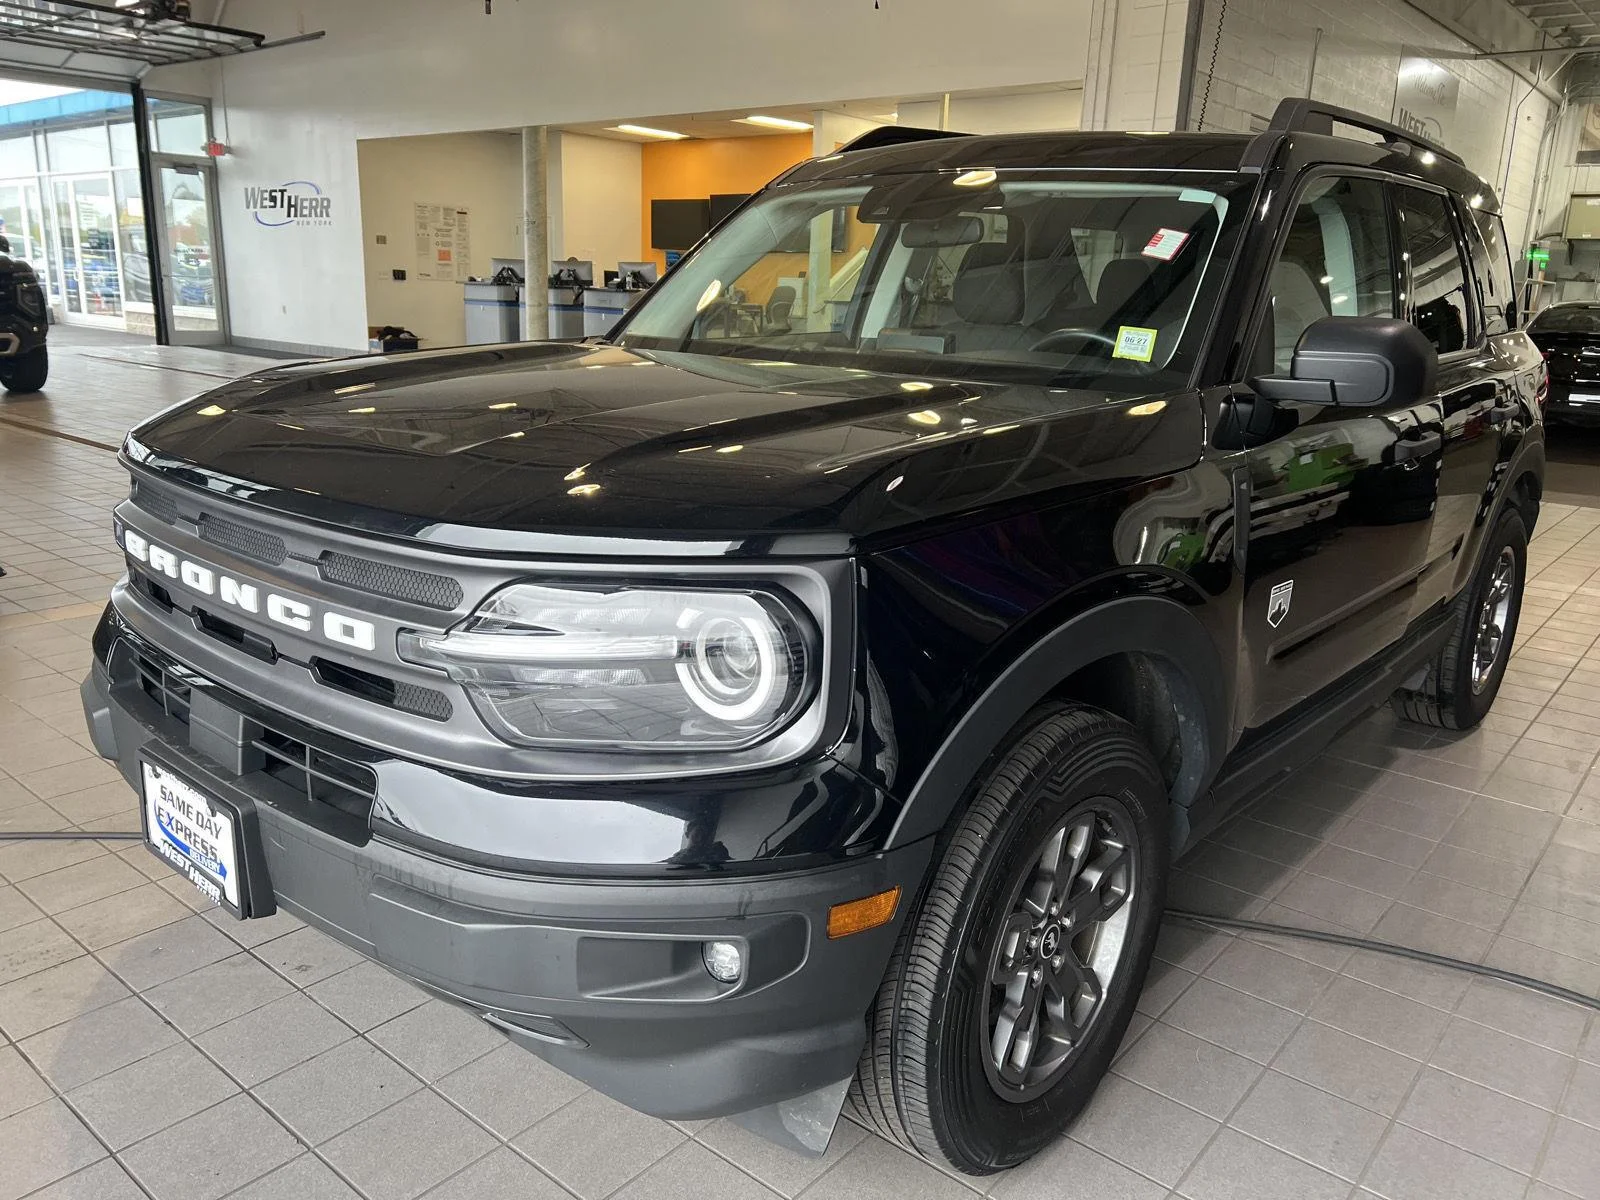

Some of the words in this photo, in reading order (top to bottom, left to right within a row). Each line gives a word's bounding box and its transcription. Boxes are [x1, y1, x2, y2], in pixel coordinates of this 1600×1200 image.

[244, 187, 287, 209] WEST
[287, 195, 331, 218] HERR
[125, 529, 375, 651] BRONCO
[158, 807, 218, 860] EXPRESS
[160, 784, 193, 821] SAME
[196, 810, 222, 839] DAY
[159, 841, 192, 872] WEST
